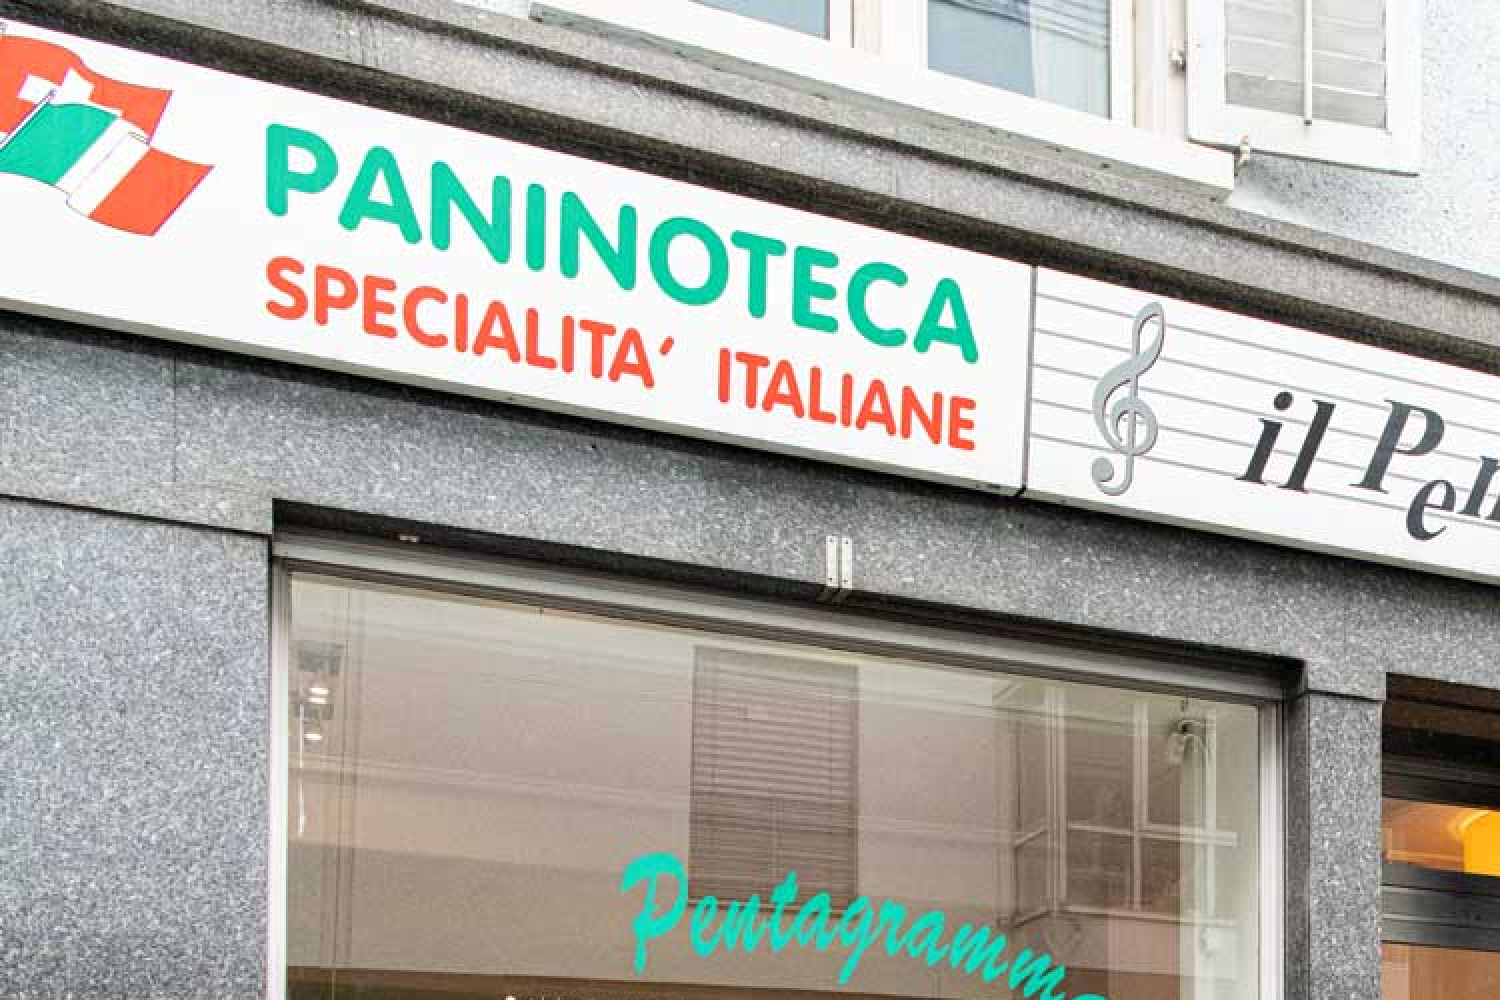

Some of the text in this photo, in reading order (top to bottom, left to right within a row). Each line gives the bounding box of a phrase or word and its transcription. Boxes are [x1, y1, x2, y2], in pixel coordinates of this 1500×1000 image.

[264, 122, 981, 365] PANINOTECA
[717, 347, 977, 452] ITALIANE
[1236, 391, 1335, 494] il
